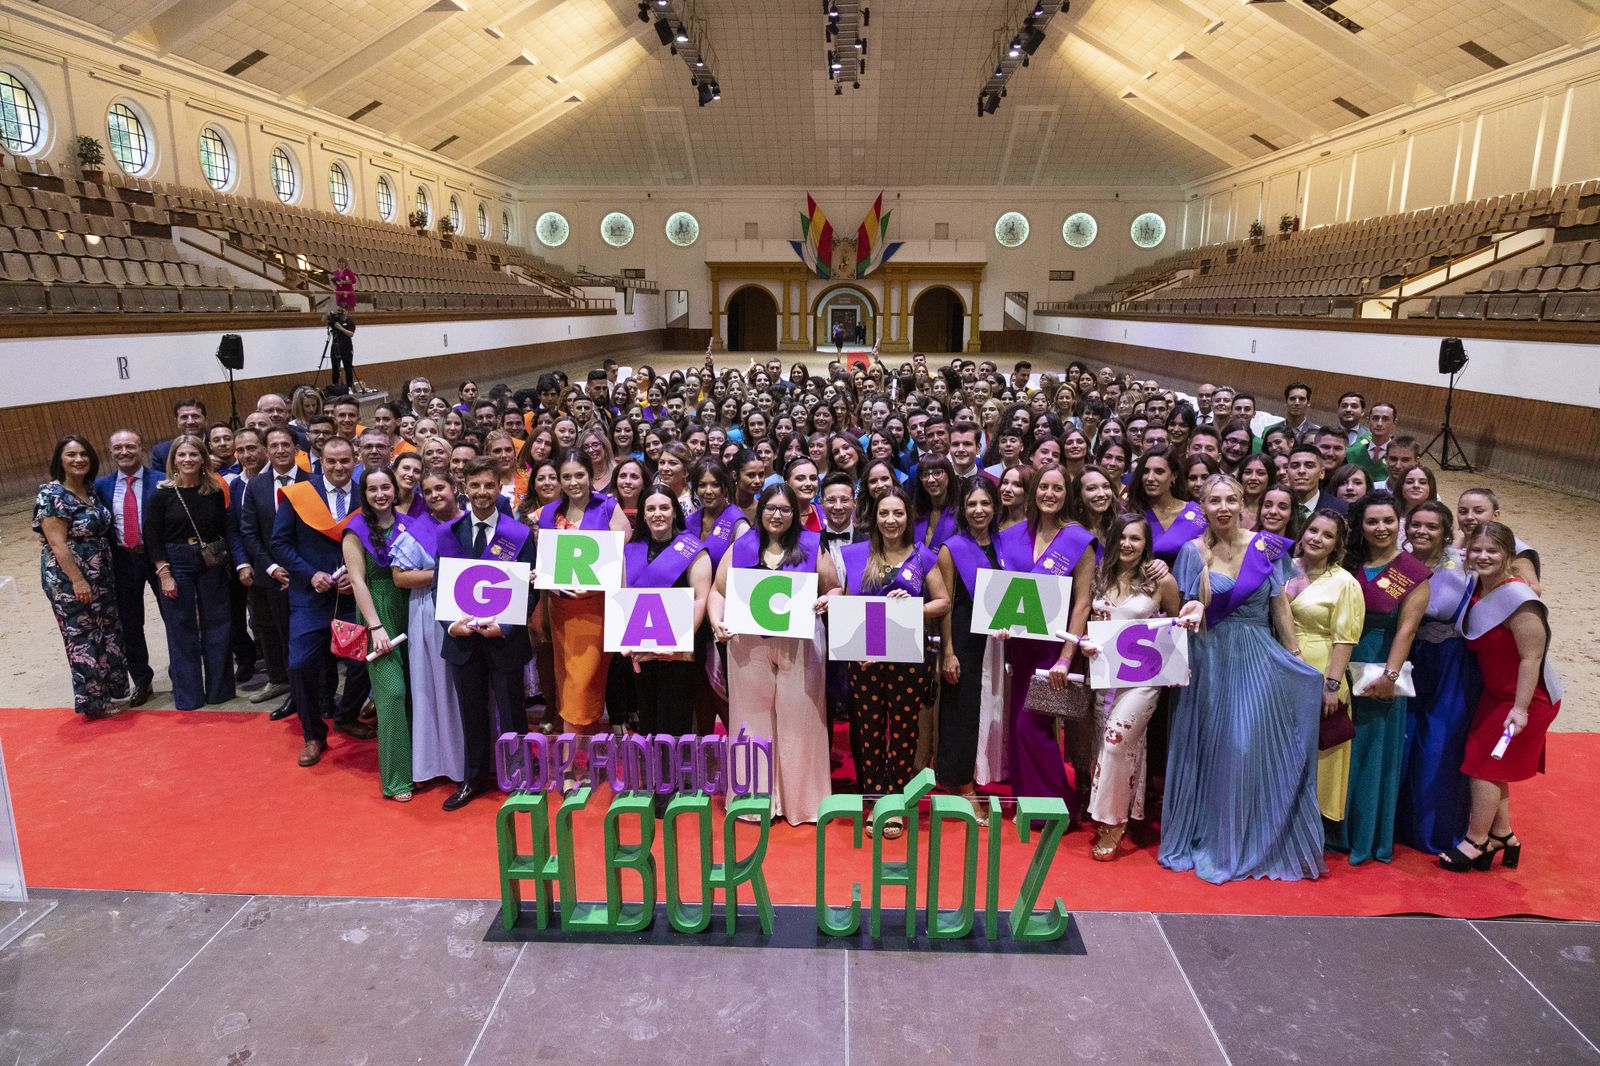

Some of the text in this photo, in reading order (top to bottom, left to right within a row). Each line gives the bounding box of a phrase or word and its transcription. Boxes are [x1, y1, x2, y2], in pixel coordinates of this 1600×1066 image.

[117, 356, 130, 380] R
[454, 534, 1163, 683] G R A C I A S
[588, 721, 774, 795] FUNDACIÓN
[496, 767, 1070, 942] ALBOR CÁDIZ
